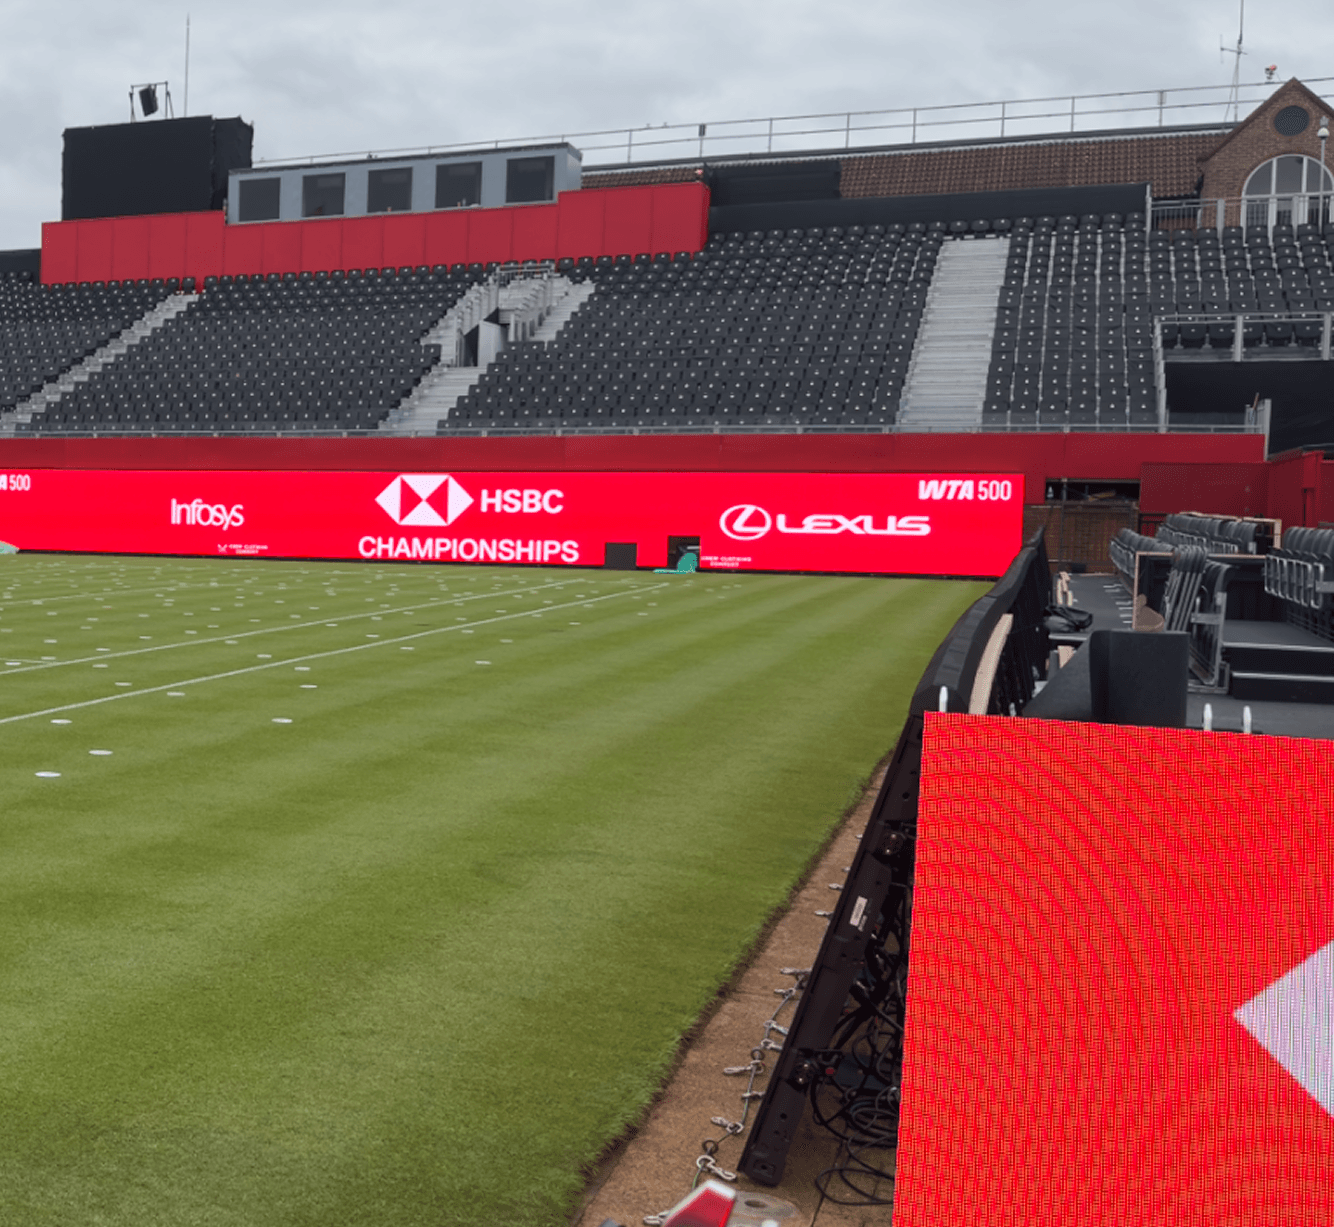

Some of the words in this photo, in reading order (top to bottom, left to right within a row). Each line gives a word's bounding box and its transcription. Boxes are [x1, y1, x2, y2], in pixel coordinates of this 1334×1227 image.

[9, 474, 31, 491] 500
[918, 479, 974, 501] WTA
[977, 479, 1012, 501] 500
[480, 488, 564, 514] HSBC
[170, 498, 245, 531] Infosys
[776, 513, 932, 536] LEXUS
[358, 535, 580, 563] CHAMPIONSHIPS
